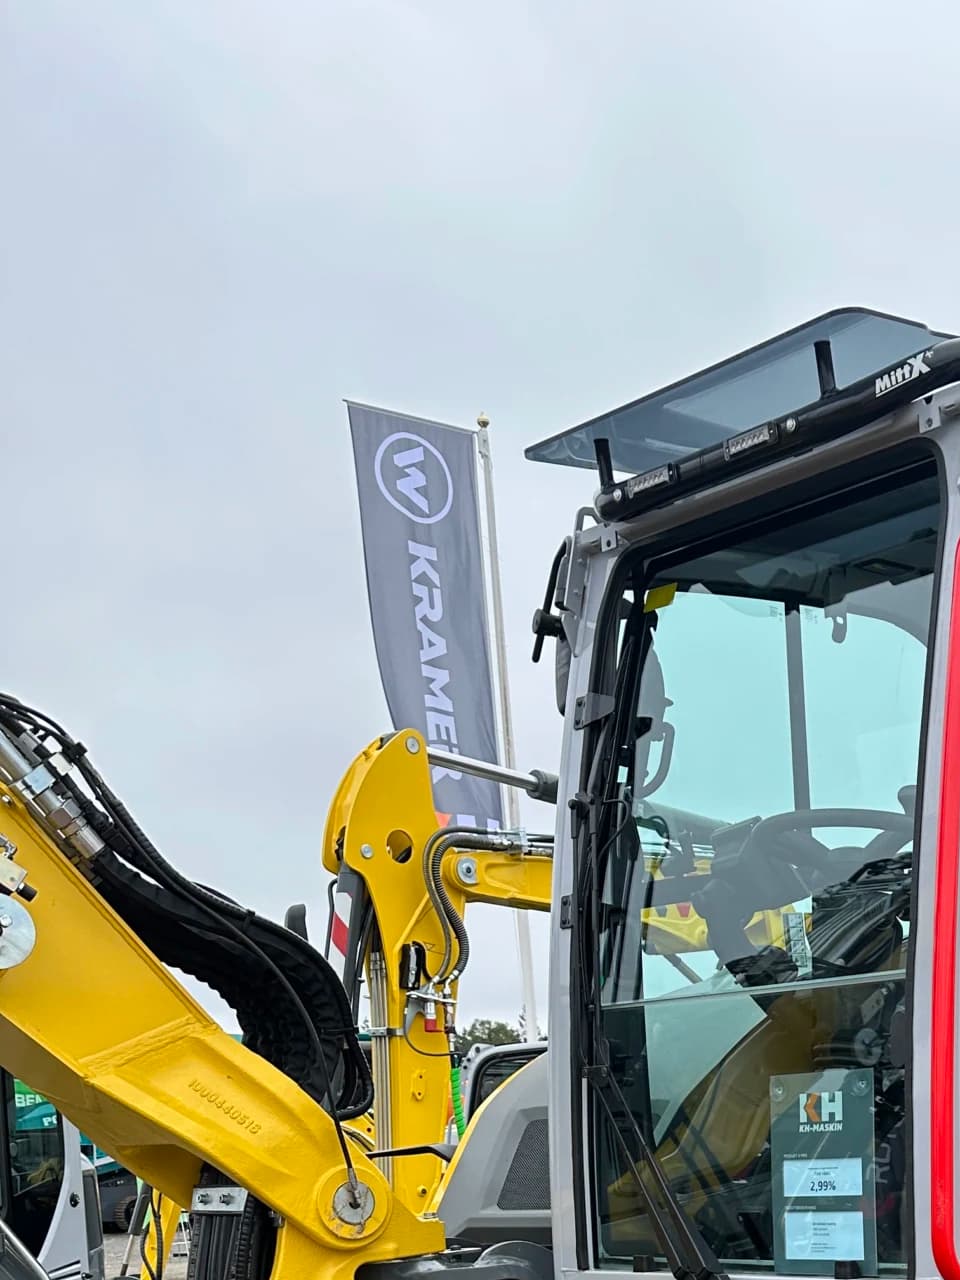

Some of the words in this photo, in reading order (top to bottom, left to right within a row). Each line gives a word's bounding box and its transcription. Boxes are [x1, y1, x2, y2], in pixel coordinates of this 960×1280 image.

[407, 539, 463, 785] KRAMER
[799, 1090, 843, 1123] KH
[799, 1123, 843, 1133] KH-MASKIN
[810, 1180, 836, 1193] 2,99%
